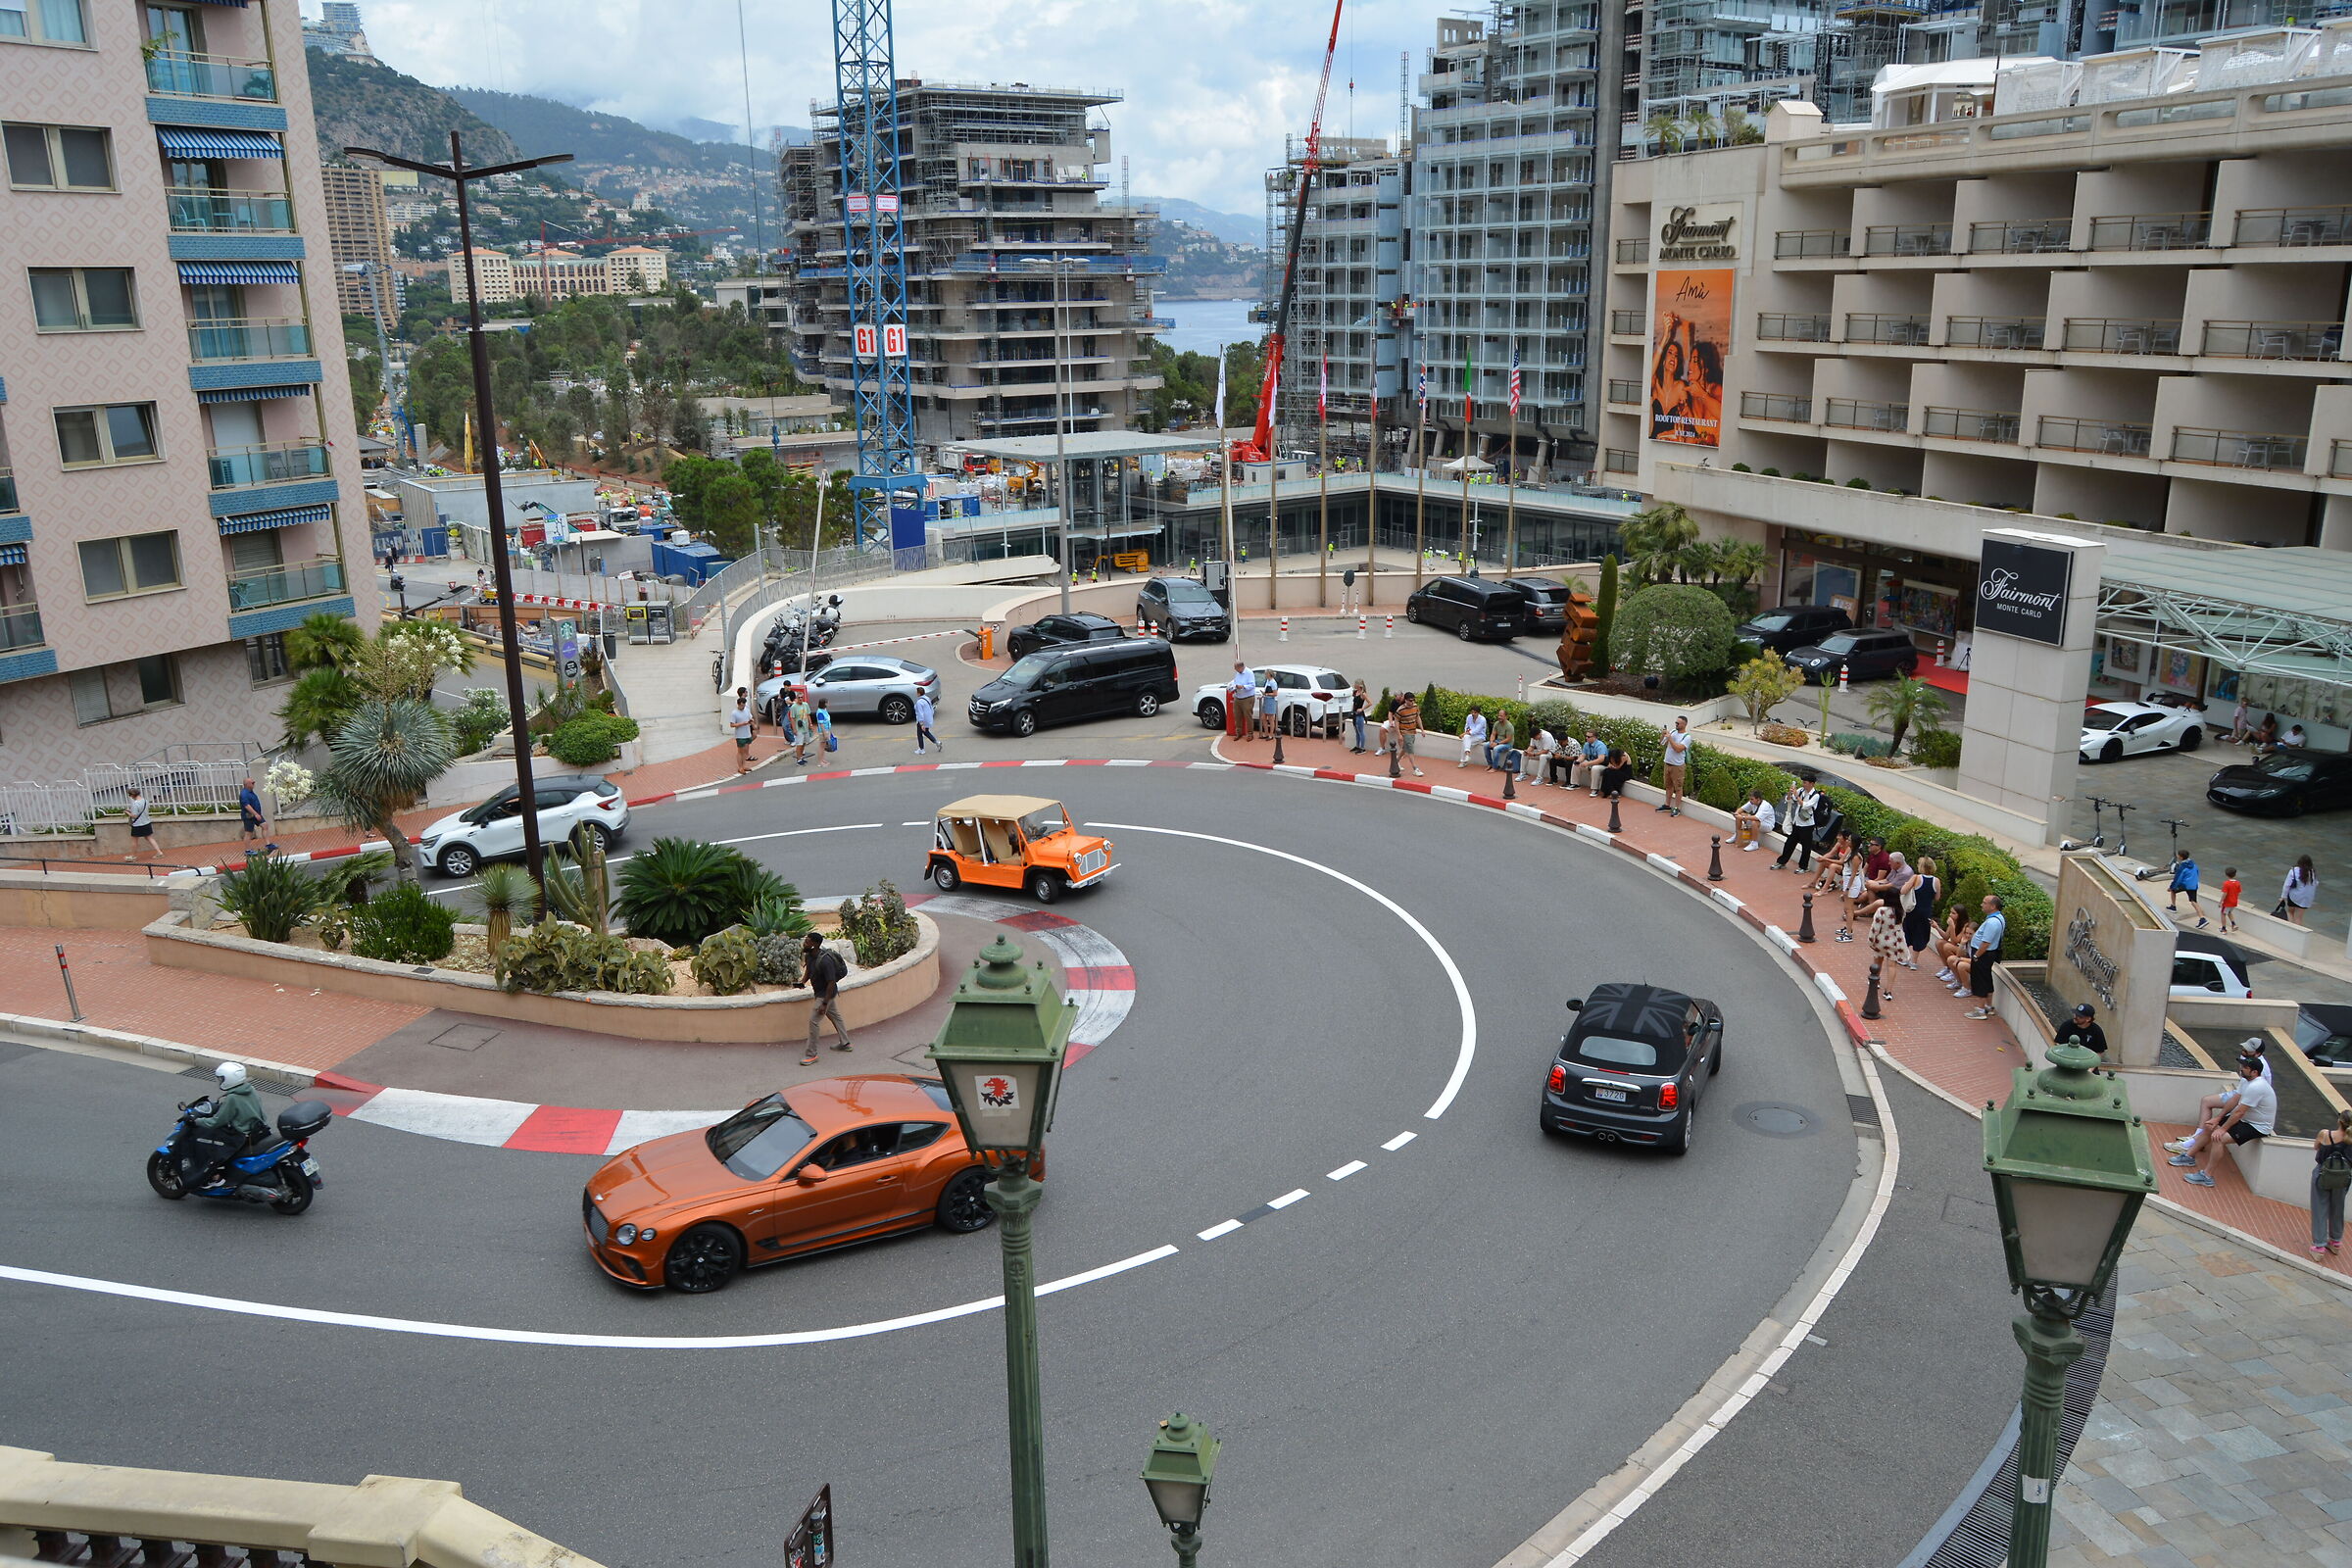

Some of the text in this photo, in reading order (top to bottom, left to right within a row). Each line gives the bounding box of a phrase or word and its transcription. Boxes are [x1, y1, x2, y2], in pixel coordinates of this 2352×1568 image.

[1660, 206, 1736, 245] Fairmont
[1658, 245, 1736, 260] MONTE CARLO
[857, 328, 874, 353] G1
[887, 327, 904, 353] G1
[1654, 414, 1718, 428] ROOFTOP RESTAURANT
[1980, 567, 2063, 612] Fairmont
[1996, 603, 2042, 618] MONTE CARLO
